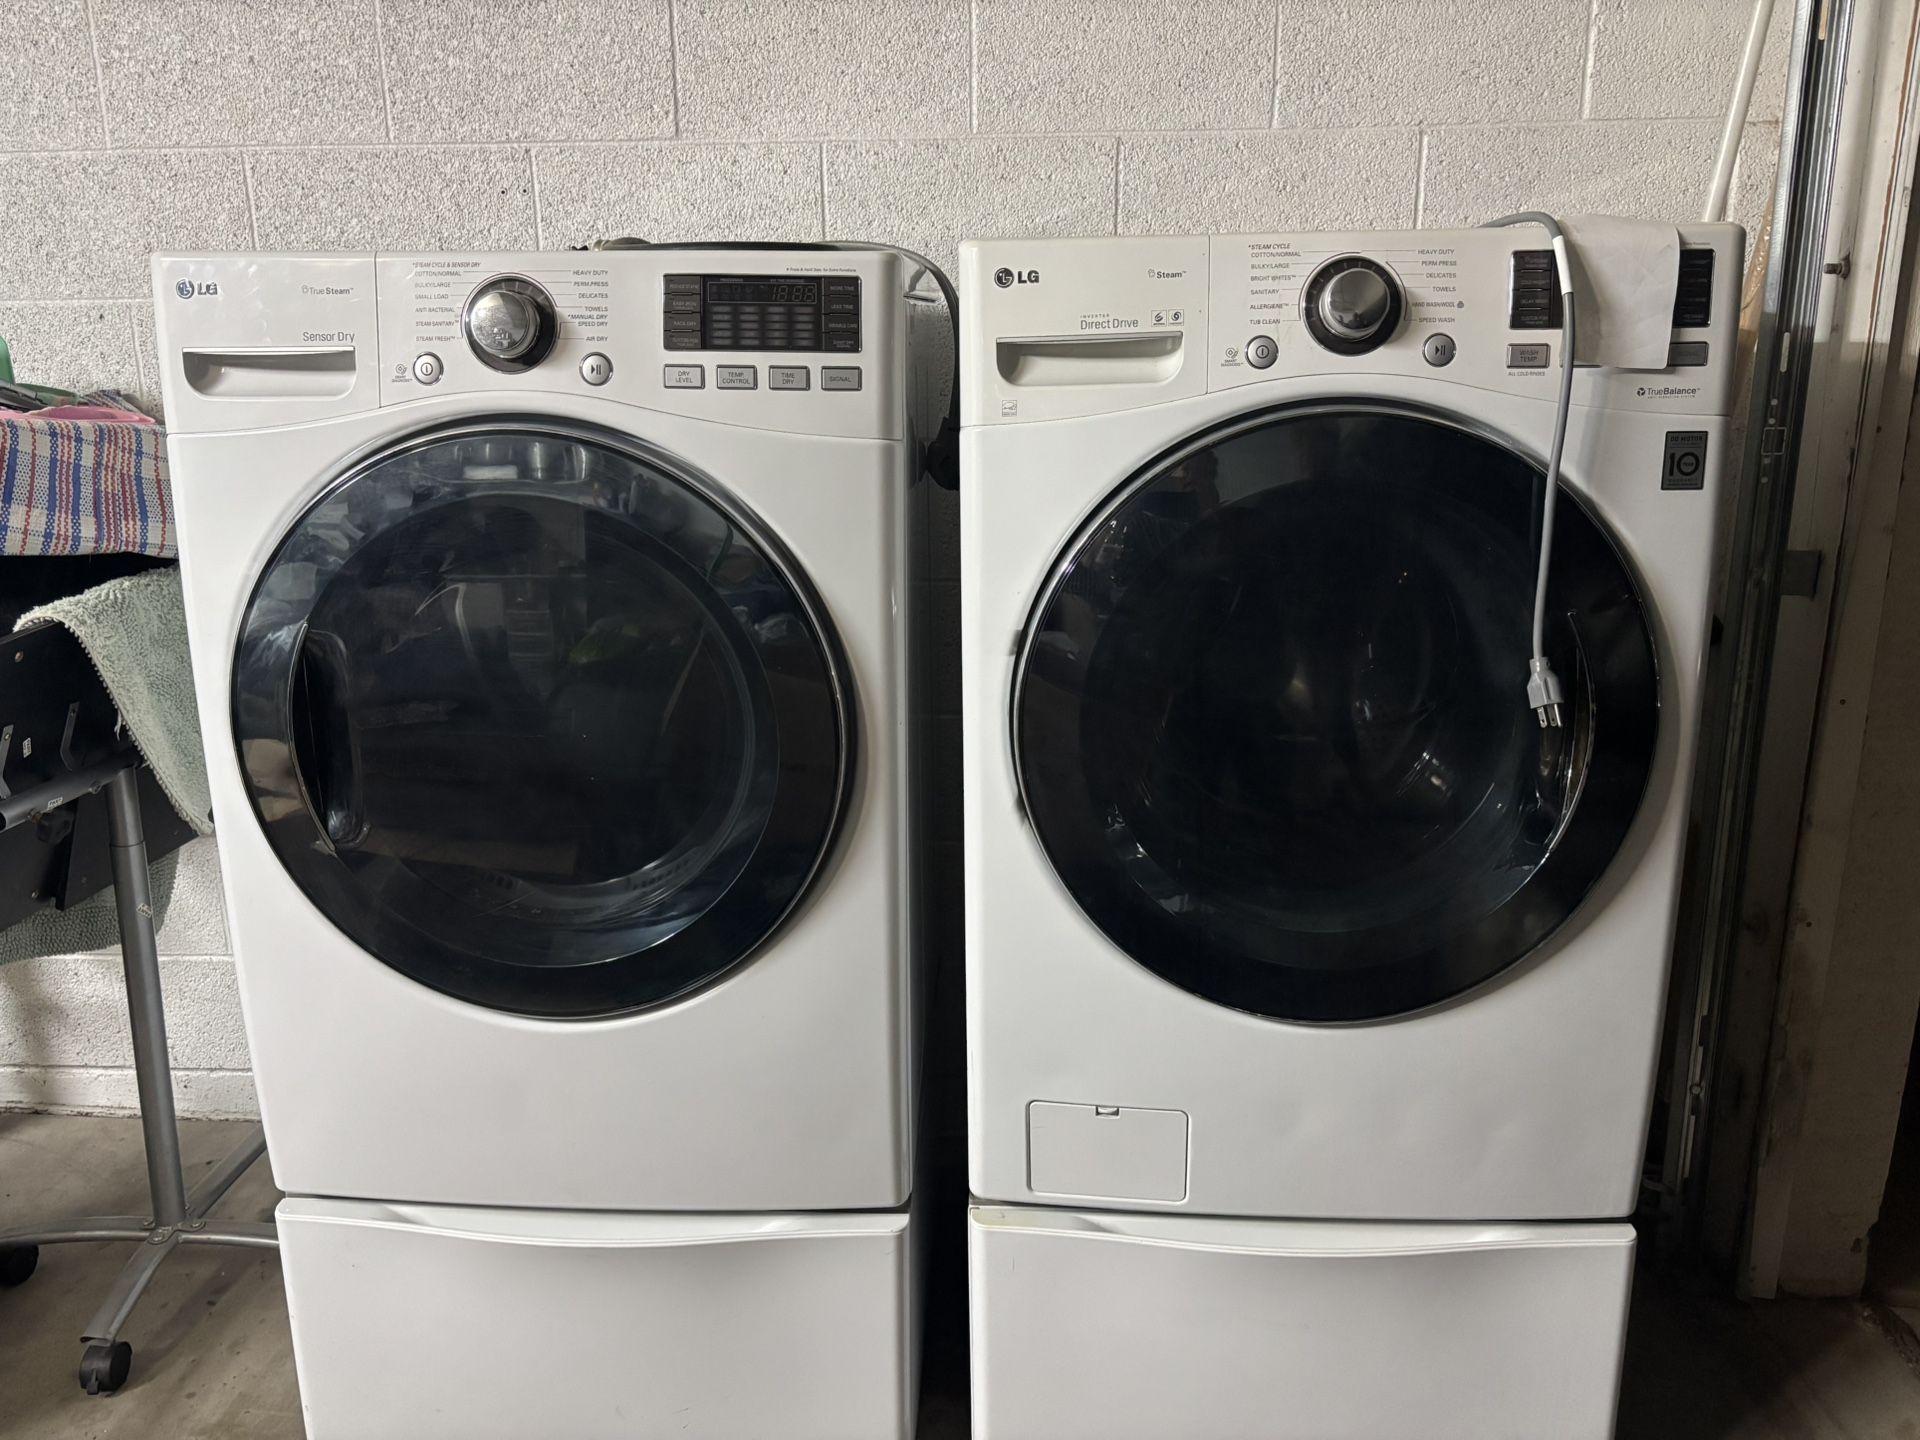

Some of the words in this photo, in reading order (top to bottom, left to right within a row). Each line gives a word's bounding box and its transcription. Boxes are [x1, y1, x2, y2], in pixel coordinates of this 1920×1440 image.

[1017, 270, 1040, 284] LG
[197, 282, 217, 295] LG
[1080, 320, 1111, 330] Direct
[1112, 318, 1138, 328] Drive
[303, 331, 335, 342] Sensor
[338, 331, 355, 343] Dry
[1669, 452, 1700, 476] 10
